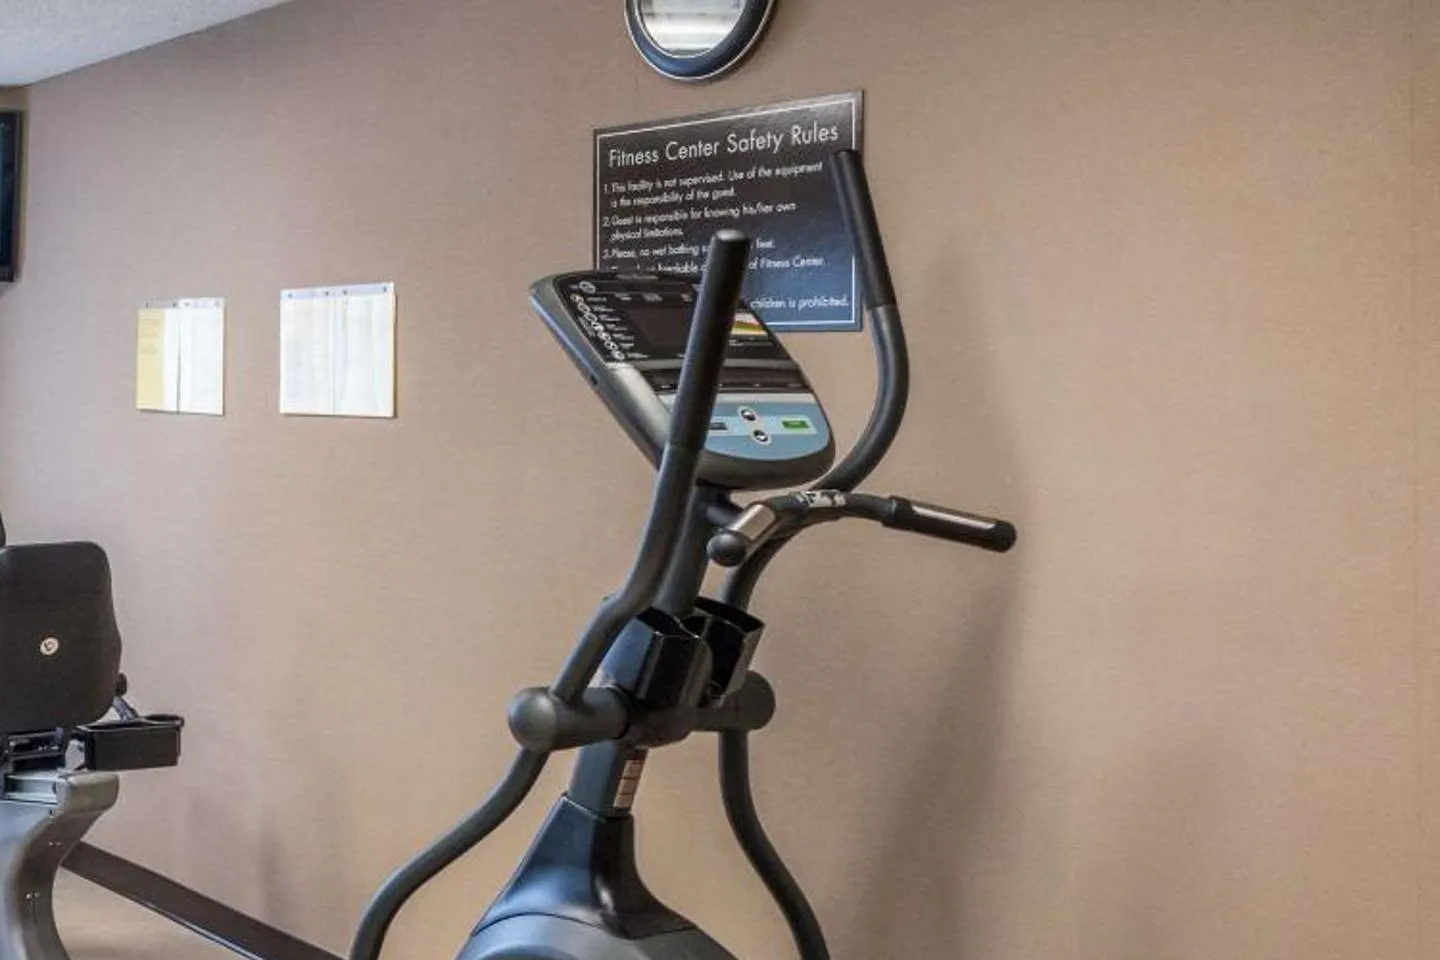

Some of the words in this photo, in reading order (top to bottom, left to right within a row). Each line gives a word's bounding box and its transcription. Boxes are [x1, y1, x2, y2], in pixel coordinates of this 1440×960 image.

[608, 147, 660, 168] Fitness
[665, 139, 720, 161] Center
[727, 128, 784, 154] Safety
[791, 121, 839, 145] Rules
[664, 177, 677, 188] not
[746, 166, 756, 179] of
[758, 165, 772, 178] the
[775, 161, 823, 177] equipment
[685, 187, 695, 201] of
[697, 190, 709, 200] the
[644, 209, 688, 225] responsible
[690, 206, 702, 220] for
[704, 206, 740, 218] knowing
[776, 202, 797, 213] own
[610, 227, 642, 242] physical
[668, 243, 700, 257] bathing
[748, 256, 758, 270] of
[760, 257, 790, 269] Fitness
[799, 294, 849, 311] prohibited.
